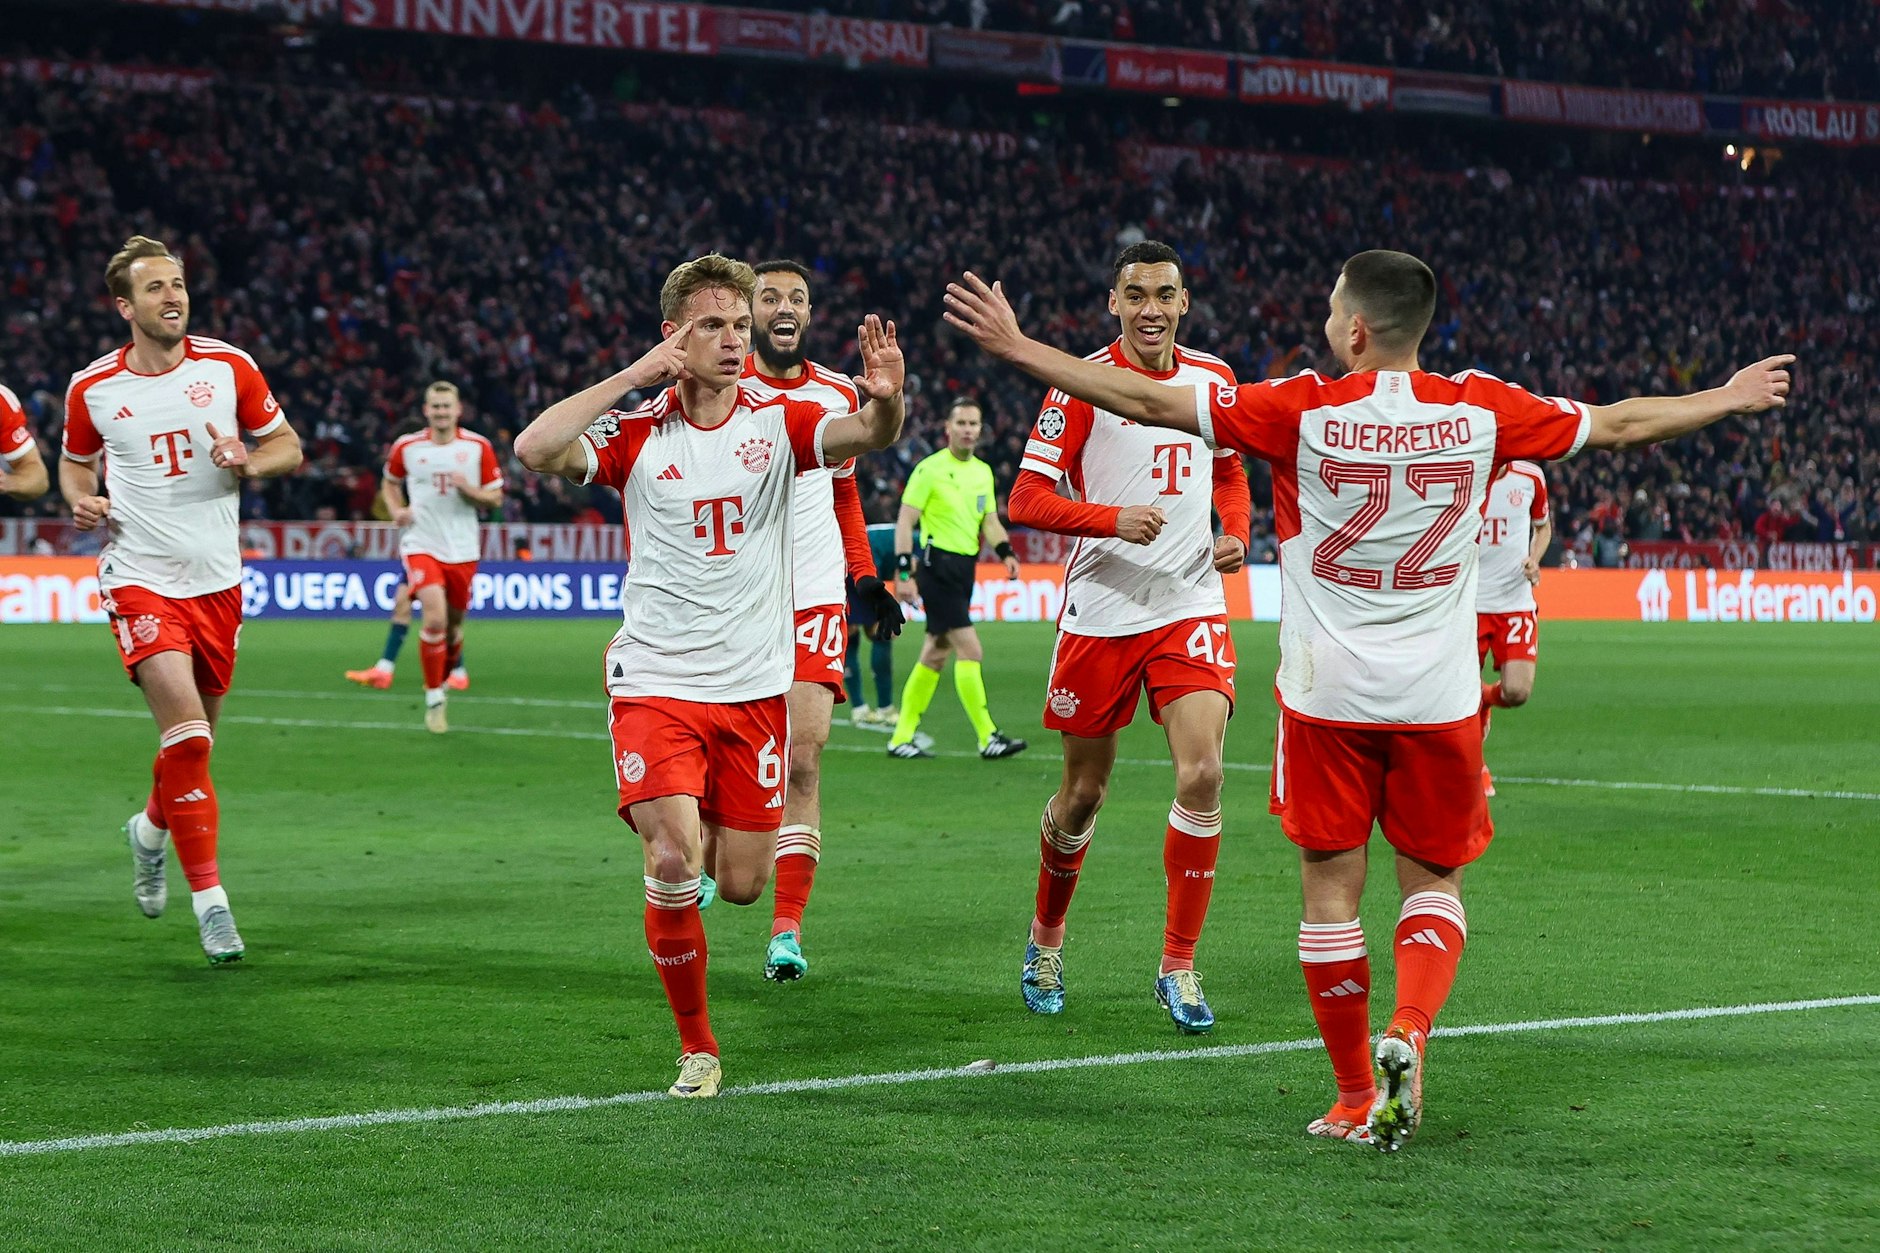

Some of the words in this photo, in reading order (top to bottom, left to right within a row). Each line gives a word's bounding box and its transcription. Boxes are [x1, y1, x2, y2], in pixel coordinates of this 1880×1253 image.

[808, 14, 928, 61] PASSAU
[150, 429, 193, 478] T
[1325, 417, 1471, 454] GUERREIRO
[1152, 443, 1191, 496] T
[693, 495, 744, 557] T
[1312, 459, 1474, 590] 22
[274, 572, 368, 611] UEFA
[374, 571, 573, 611] CPIONS
[1686, 569, 1876, 622] Lieferando
[796, 613, 843, 658] 40
[1186, 621, 1236, 668] 42
[757, 734, 782, 789] 6
